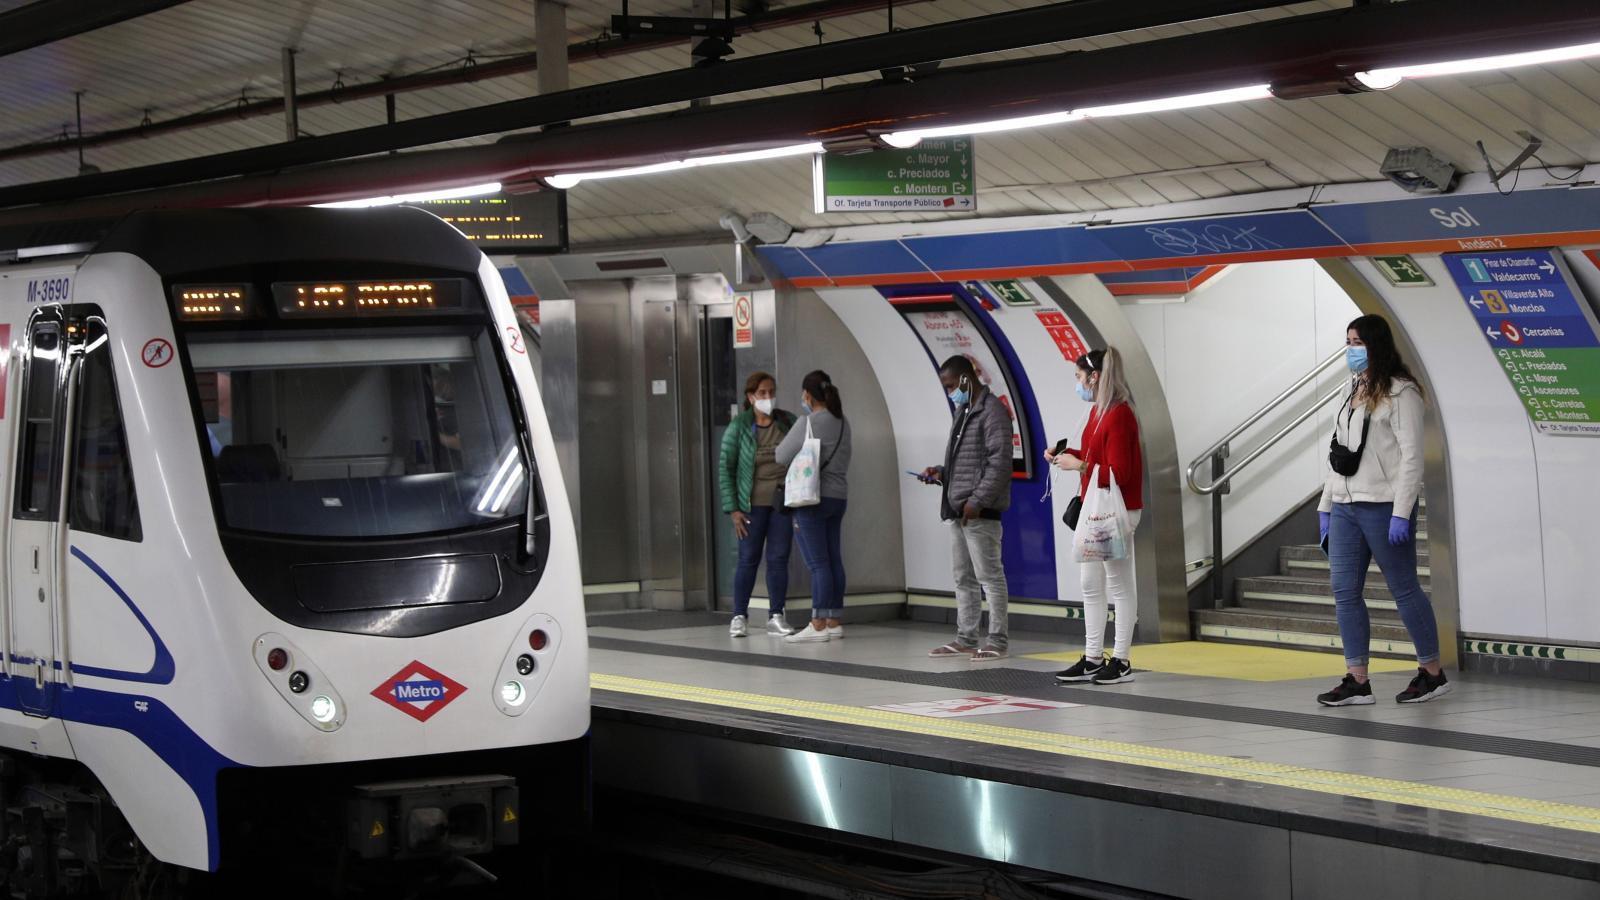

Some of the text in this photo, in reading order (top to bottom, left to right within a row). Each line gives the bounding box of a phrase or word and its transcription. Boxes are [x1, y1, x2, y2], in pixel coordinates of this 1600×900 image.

[906, 153, 950, 165] c. Mayor
[887, 168, 950, 178] c. Preciados
[893, 184, 947, 194] c. Montera
[834, 198, 941, 208] Of. Tarjeta Transporte Público
[1429, 206, 1481, 228] Sol
[1494, 237, 1507, 248] 2
[1491, 272, 1541, 282] Valdecarros
[27, 277, 69, 302] M-3690
[1485, 288, 1555, 311] 3 Villaverde Alto
[1509, 303, 1546, 313] Moncloa
[1526, 361, 1567, 370] Preciados
[1533, 374, 1559, 384] Mayor
[397, 685, 441, 698] Metro
